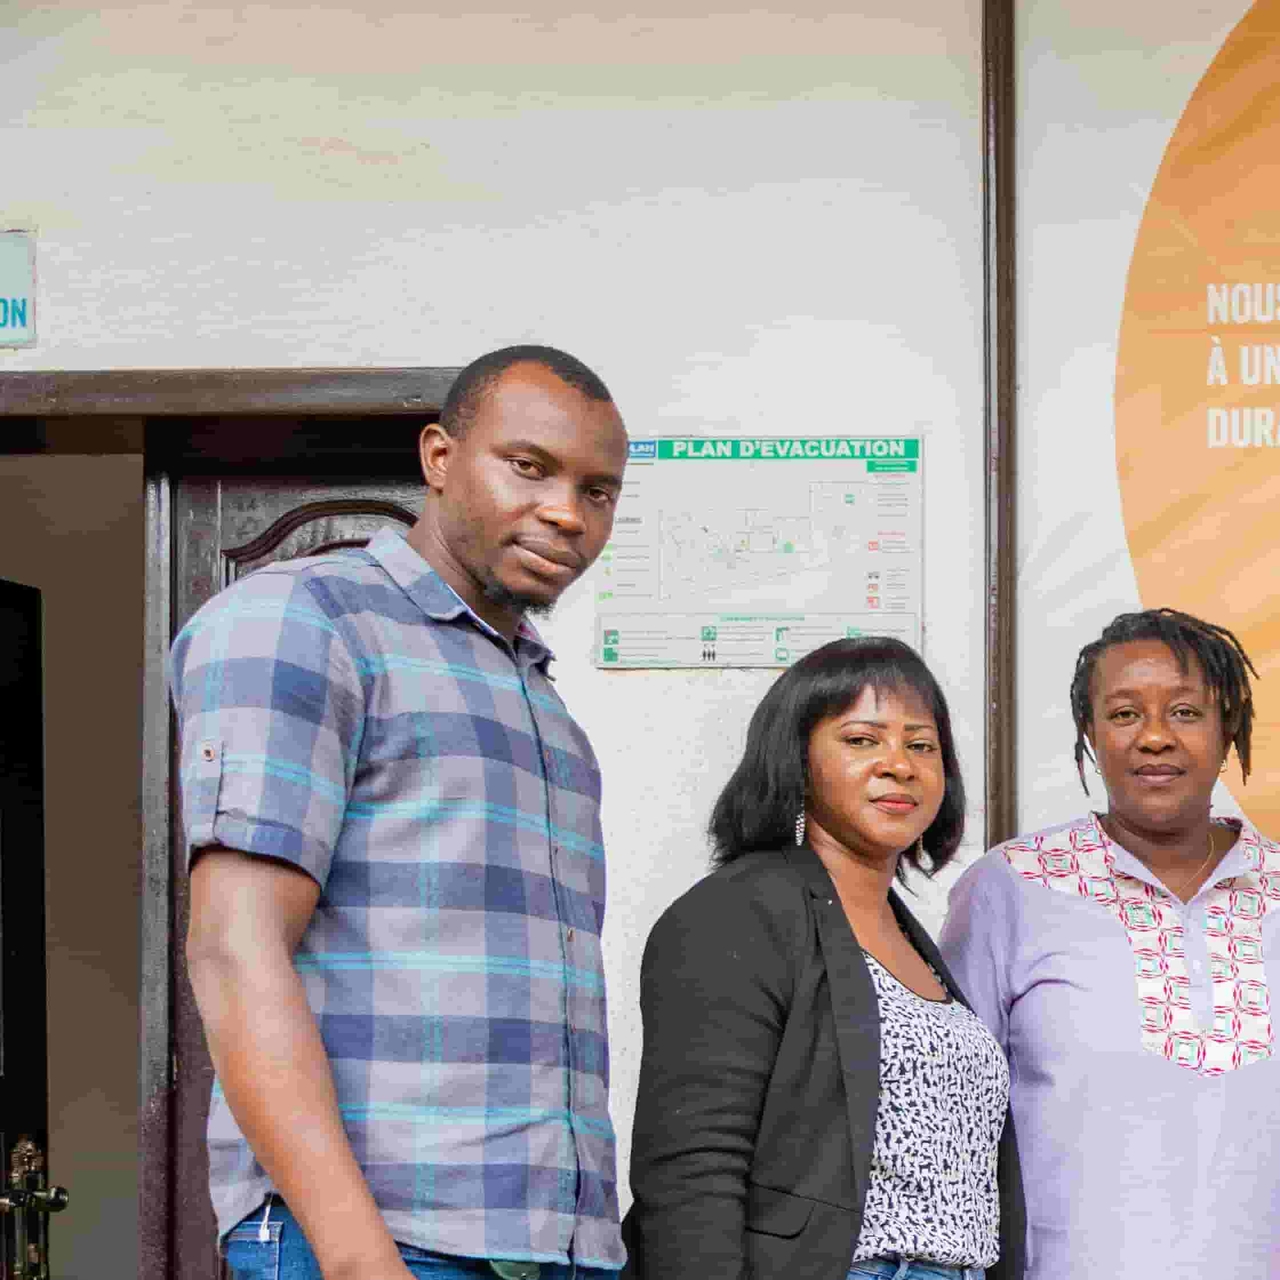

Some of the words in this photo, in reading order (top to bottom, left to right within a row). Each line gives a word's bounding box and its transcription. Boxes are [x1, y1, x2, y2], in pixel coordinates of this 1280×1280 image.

[1207, 336, 1228, 385] À
[672, 441, 733, 457] PLAN
[739, 440, 905, 457] D'EVACUATION
